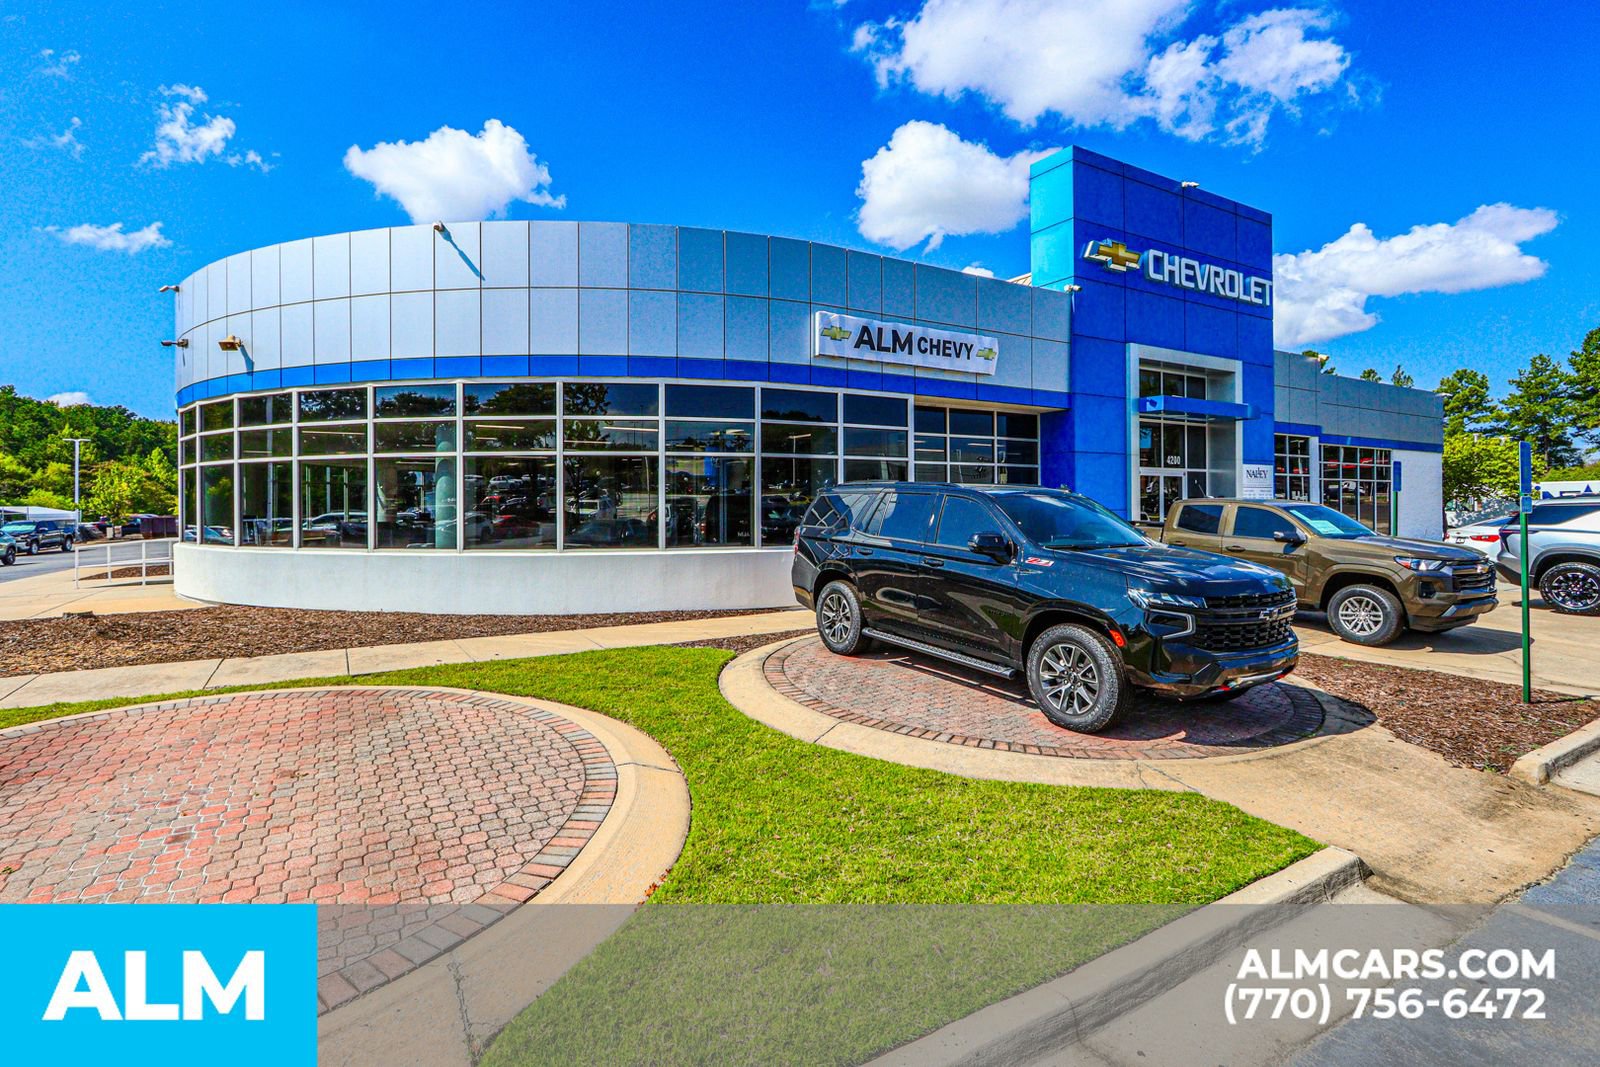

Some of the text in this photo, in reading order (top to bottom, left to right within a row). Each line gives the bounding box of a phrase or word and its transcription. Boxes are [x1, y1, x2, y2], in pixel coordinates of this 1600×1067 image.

[1145, 249, 1273, 306] CHEVROLET
[853, 325, 975, 361] ALM CHEVY
